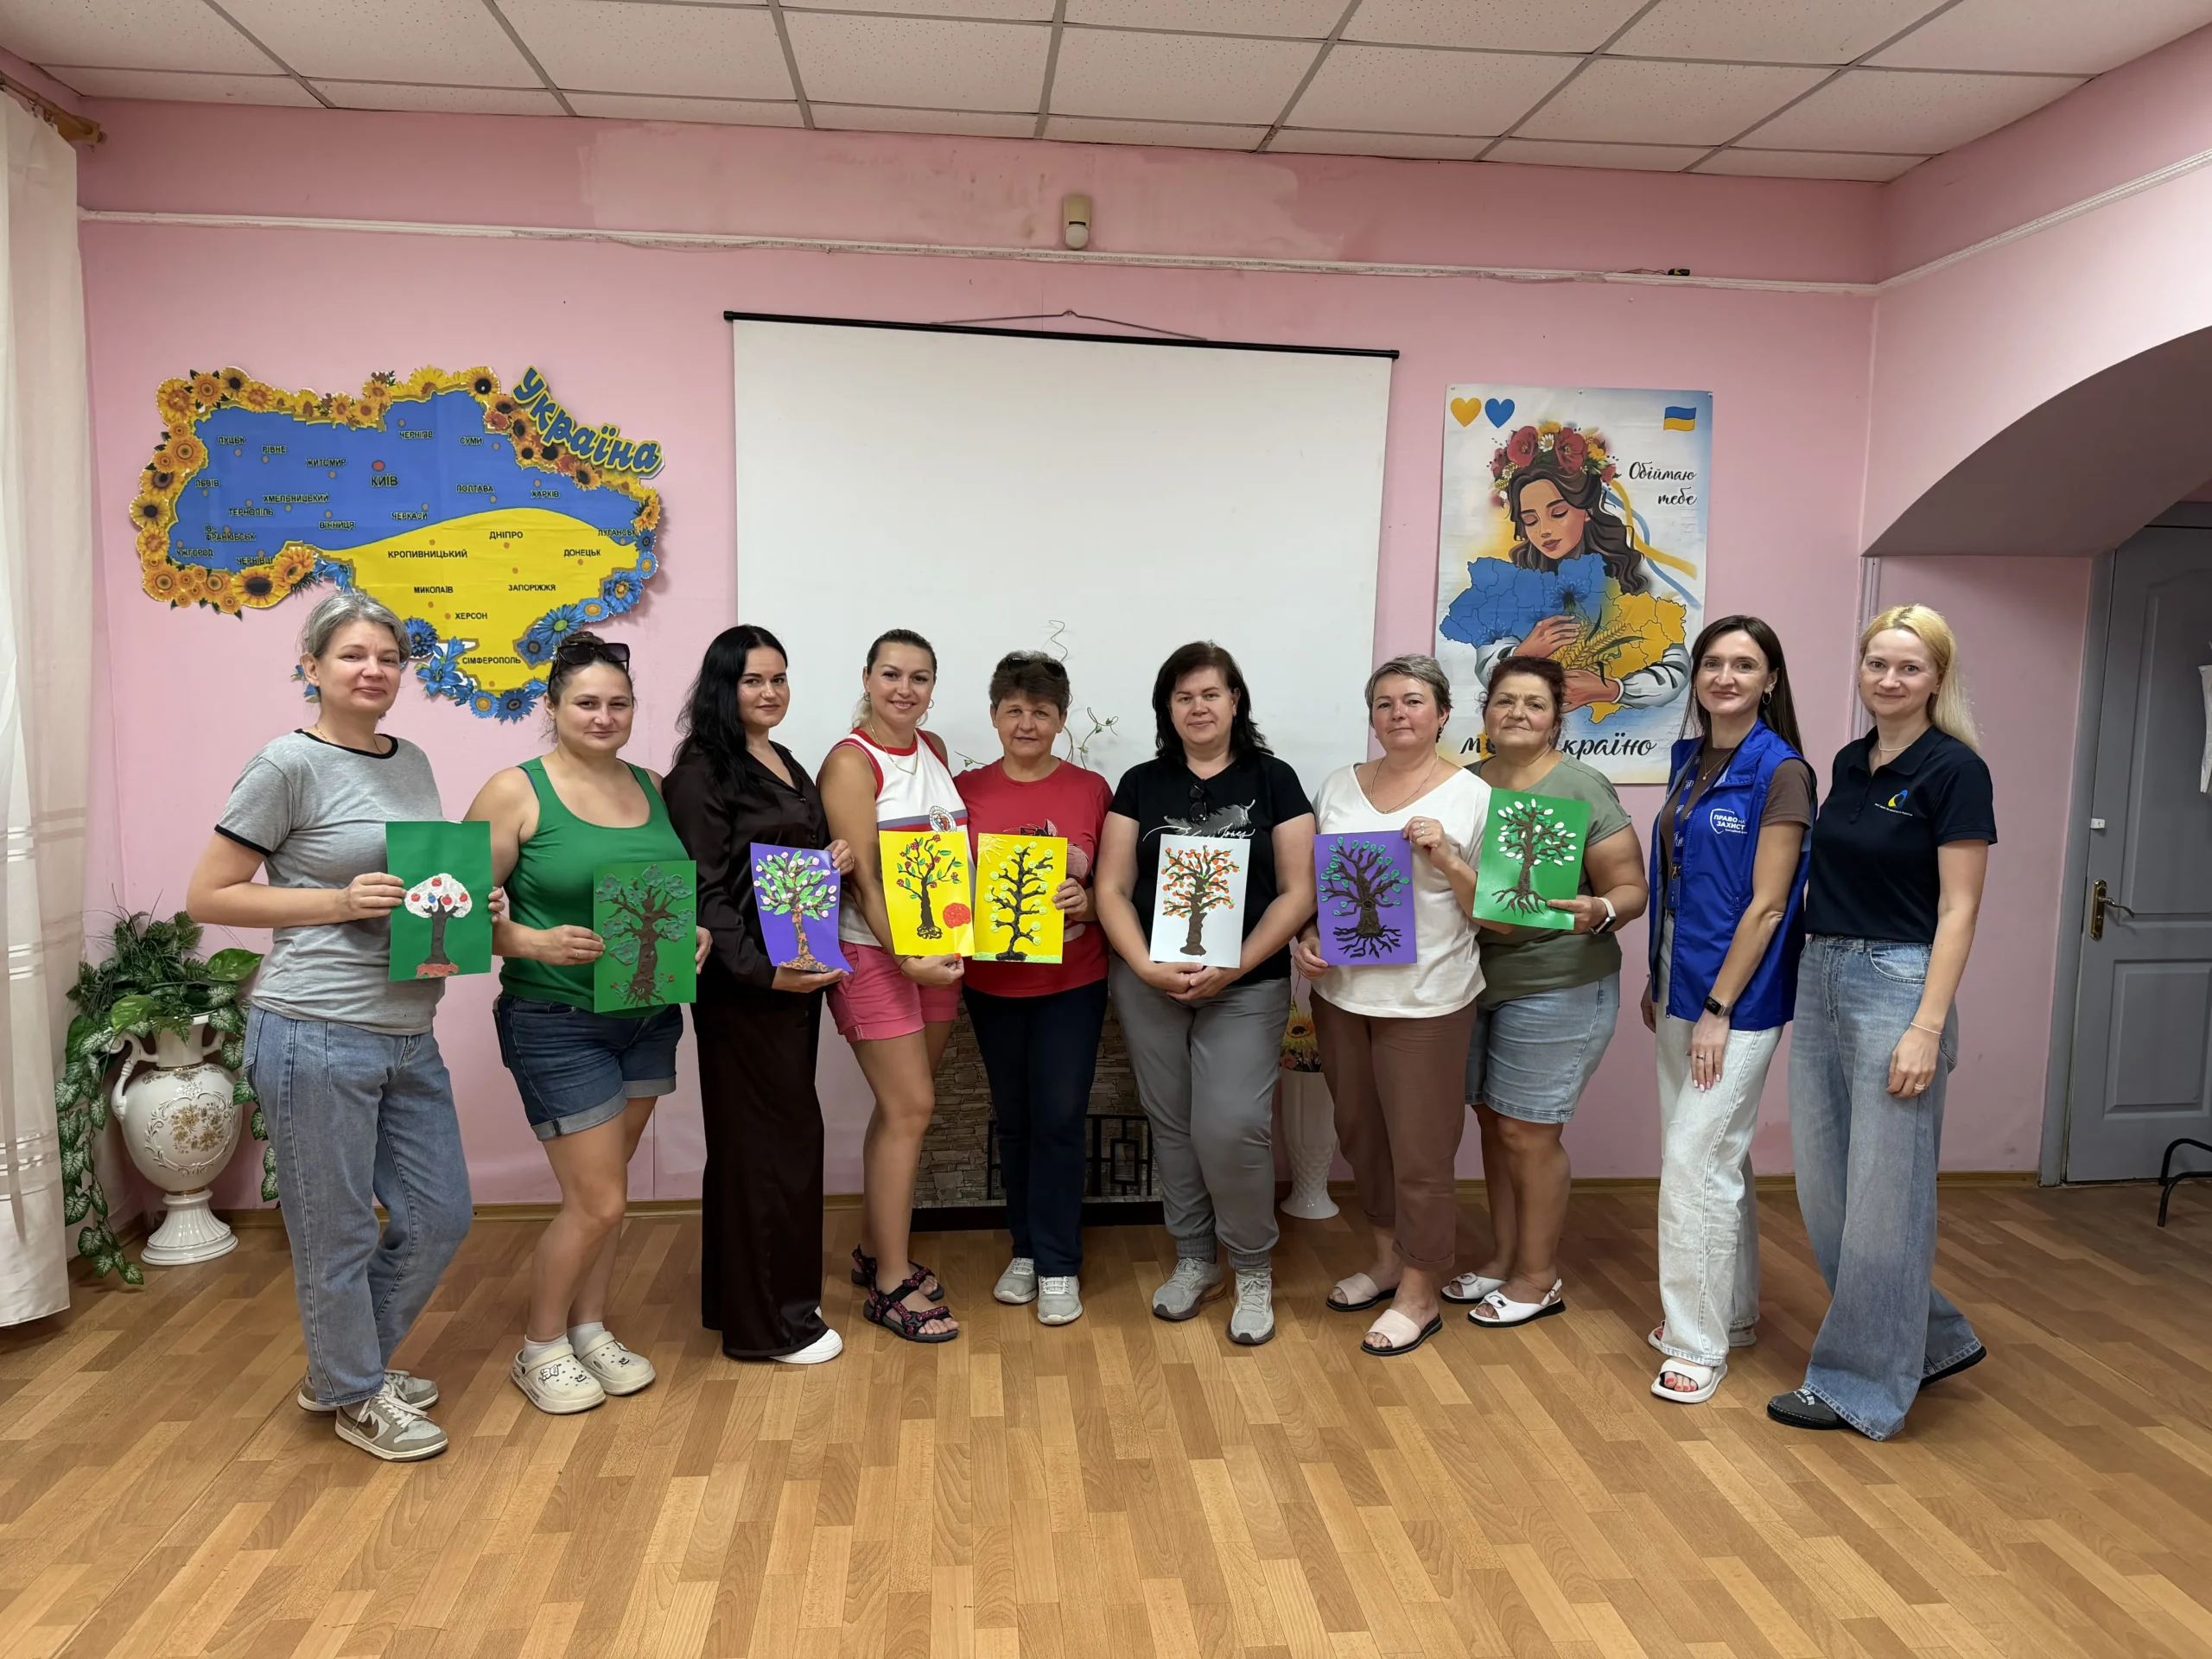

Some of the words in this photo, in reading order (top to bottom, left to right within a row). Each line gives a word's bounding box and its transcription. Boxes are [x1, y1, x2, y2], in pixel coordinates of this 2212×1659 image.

[512, 366, 661, 470] Україна
[218, 435, 246, 445] ЛУЦЬК
[460, 436, 483, 446] СУМИ
[262, 445, 287, 454] РІВНЕ
[306, 458, 346, 467] ЖИТОМИР
[1629, 461, 1697, 481] Обіймаю
[195, 479, 221, 488] ЛЬВІВ
[371, 474, 399, 487] КИЇВ
[456, 484, 495, 493] ПОЛТАВА
[263, 493, 330, 504] ХМЕЛЬНИЦЬКИЙ
[531, 489, 560, 499] ХАРКІВ
[1657, 486, 1698, 505] тебе
[228, 507, 275, 517] ТЕРНОПІЛЬ
[391, 511, 428, 520] ЧЕРКАСИ
[319, 520, 356, 530] ВІННИЦЯ
[206, 532, 257, 542] ФРАНКІВСЬК
[489, 531, 524, 540] ДНІПРО
[176, 548, 215, 558] УЖГОРОД
[387, 549, 467, 559] КРОПИВНИЦЬКИЙ
[563, 549, 601, 558] ДОНЕЦЬК
[413, 585, 454, 594] МИКОЛАЇВ
[507, 583, 556, 593] ЗАПОРІЖЖЯ
[454, 612, 488, 620] ХЕРСОН
[461, 656, 521, 665] СІМФЕРОПОЛЬ
[1562, 732, 1657, 760] країно
[1713, 814, 1738, 823] ПРАВО
[1716, 821, 1746, 830] ЗАХИСТ
